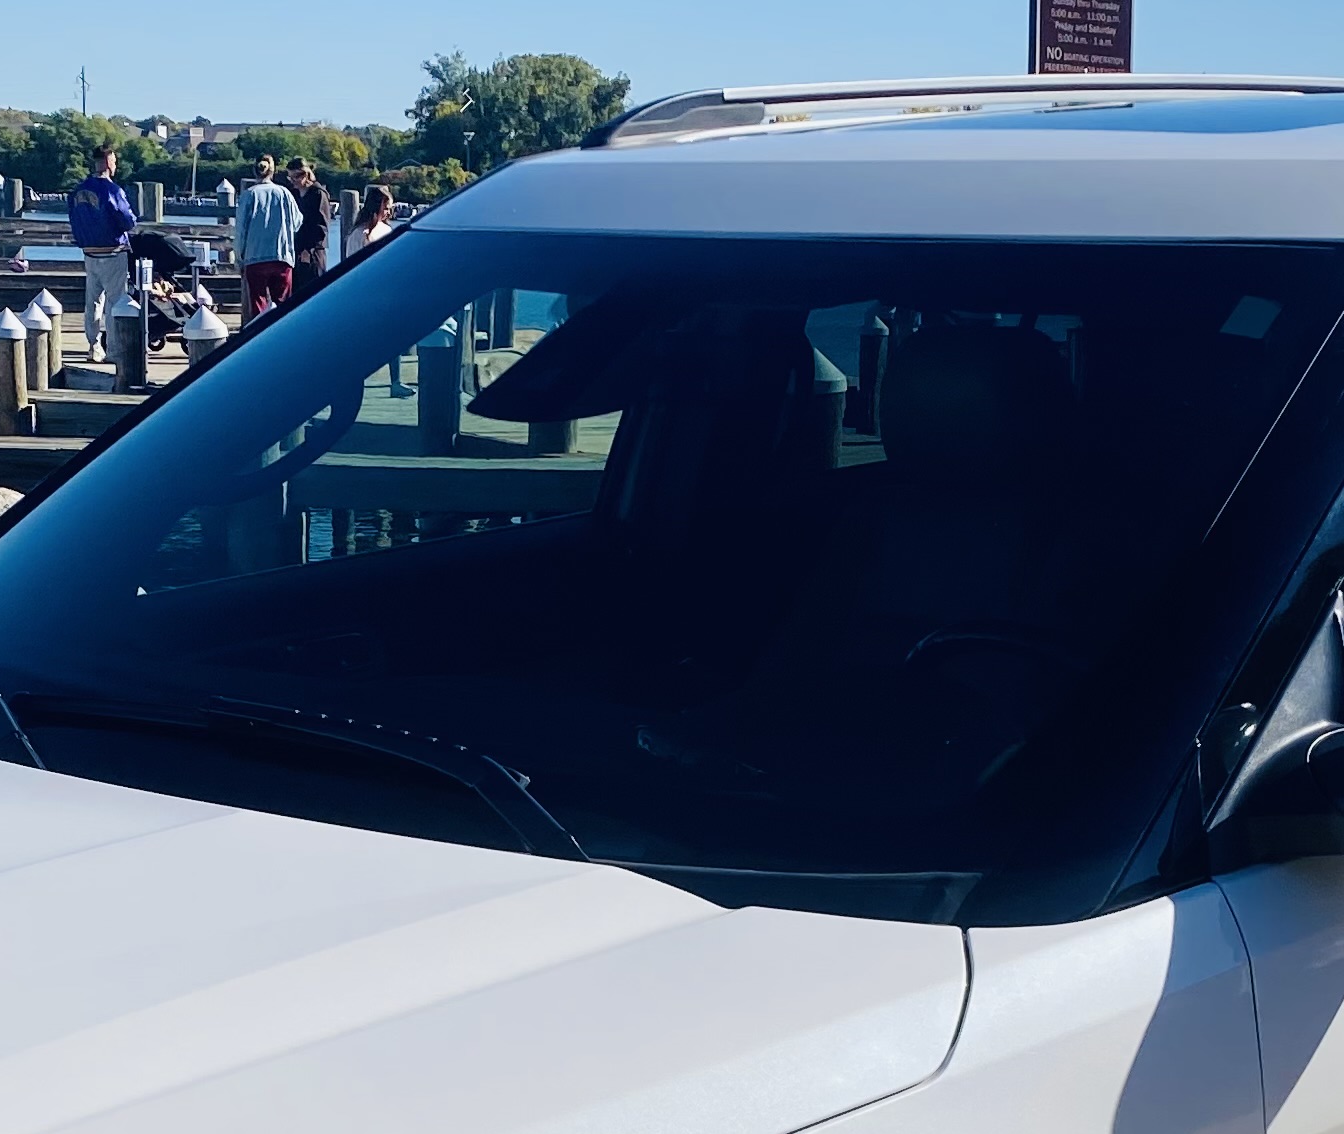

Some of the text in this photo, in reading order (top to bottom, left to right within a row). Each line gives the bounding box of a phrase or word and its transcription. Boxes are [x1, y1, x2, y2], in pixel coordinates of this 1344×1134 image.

[1054, 21, 1116, 37] Friday and Saturday
[1046, 46, 1062, 60] NO
